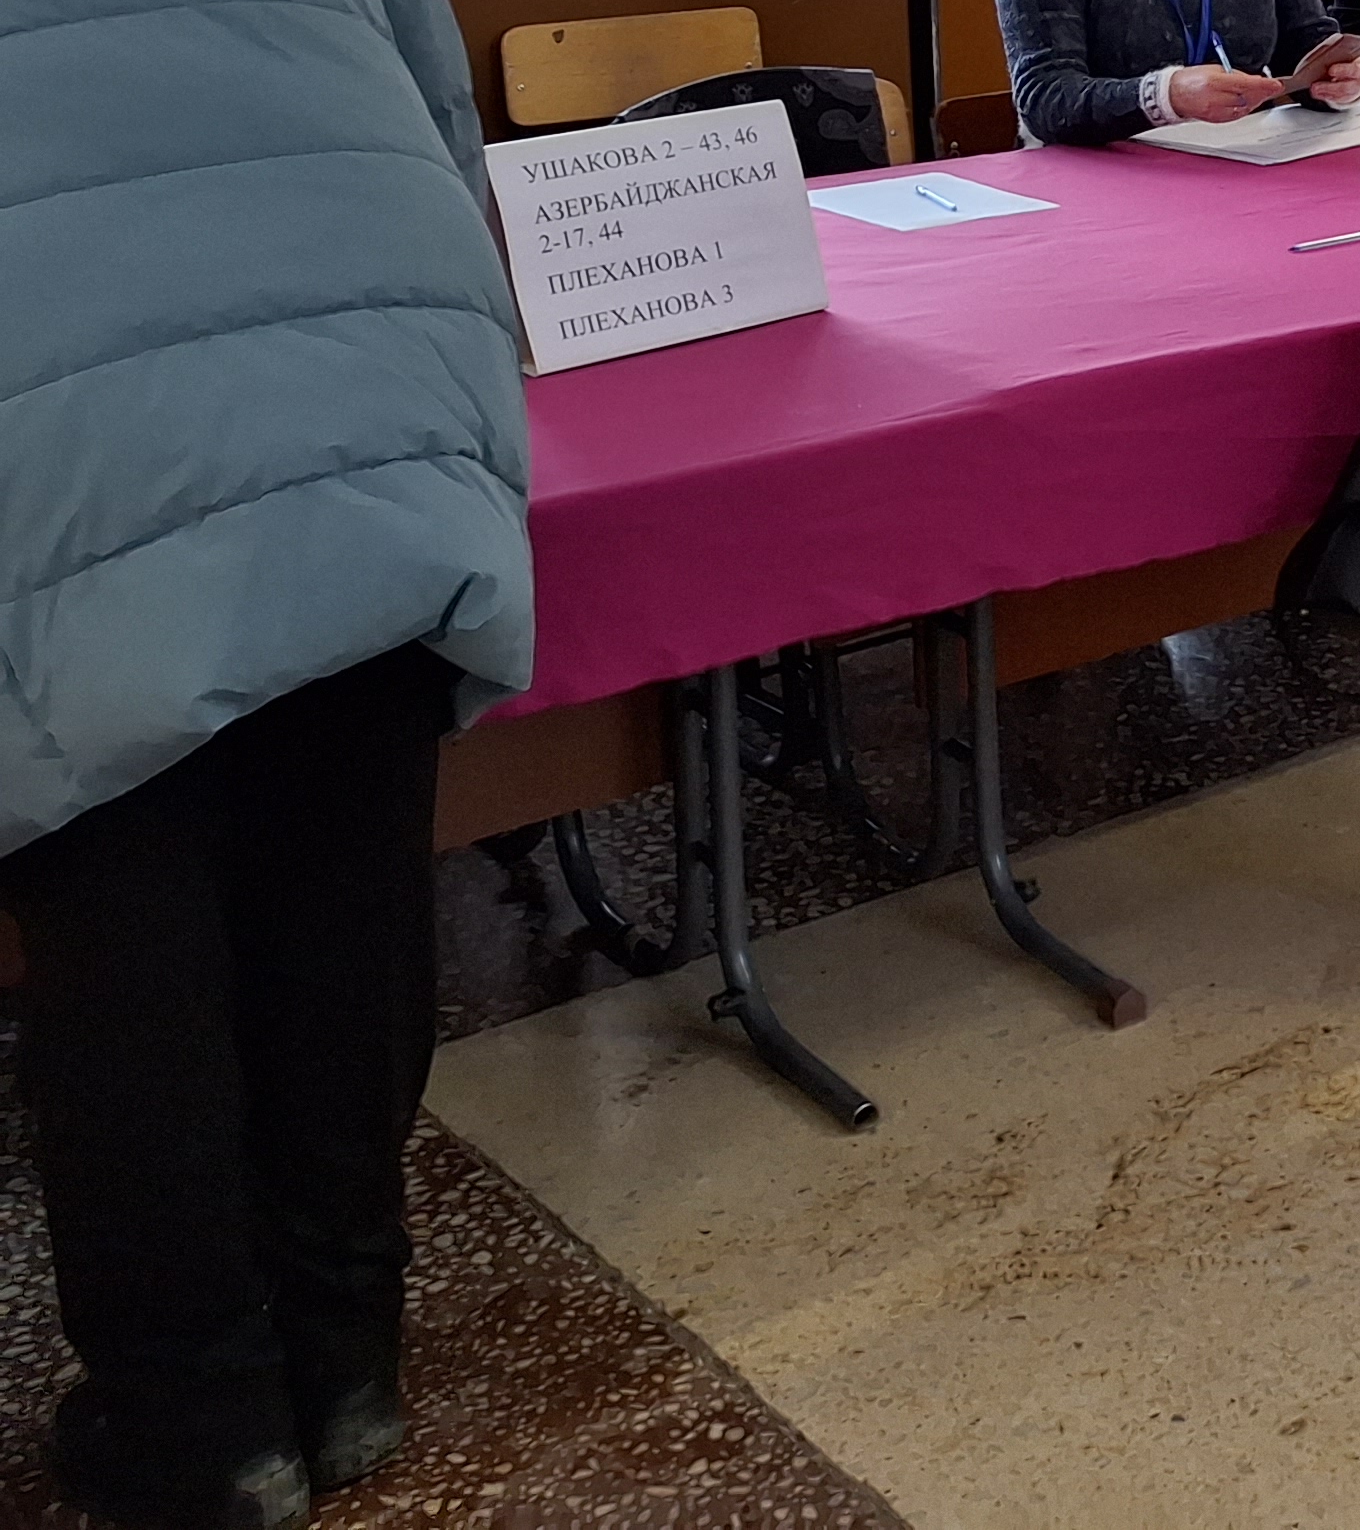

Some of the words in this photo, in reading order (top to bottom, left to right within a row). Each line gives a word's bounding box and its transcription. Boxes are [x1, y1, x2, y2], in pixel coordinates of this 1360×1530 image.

[521, 144, 658, 184] УШАКОВА
[661, 140, 676, 160] 2
[698, 132, 731, 152] 43,
[734, 125, 758, 146] 46
[534, 161, 778, 225] АЗЕРБАЙДЖАНСКАЯ
[538, 227, 594, 255] 2-17,
[598, 220, 625, 242] 44
[546, 245, 709, 295] ПЛЕХАНОВА
[713, 240, 724, 260] 1
[559, 289, 718, 341] ПЛЕХАНОВА
[721, 284, 735, 304] 3
